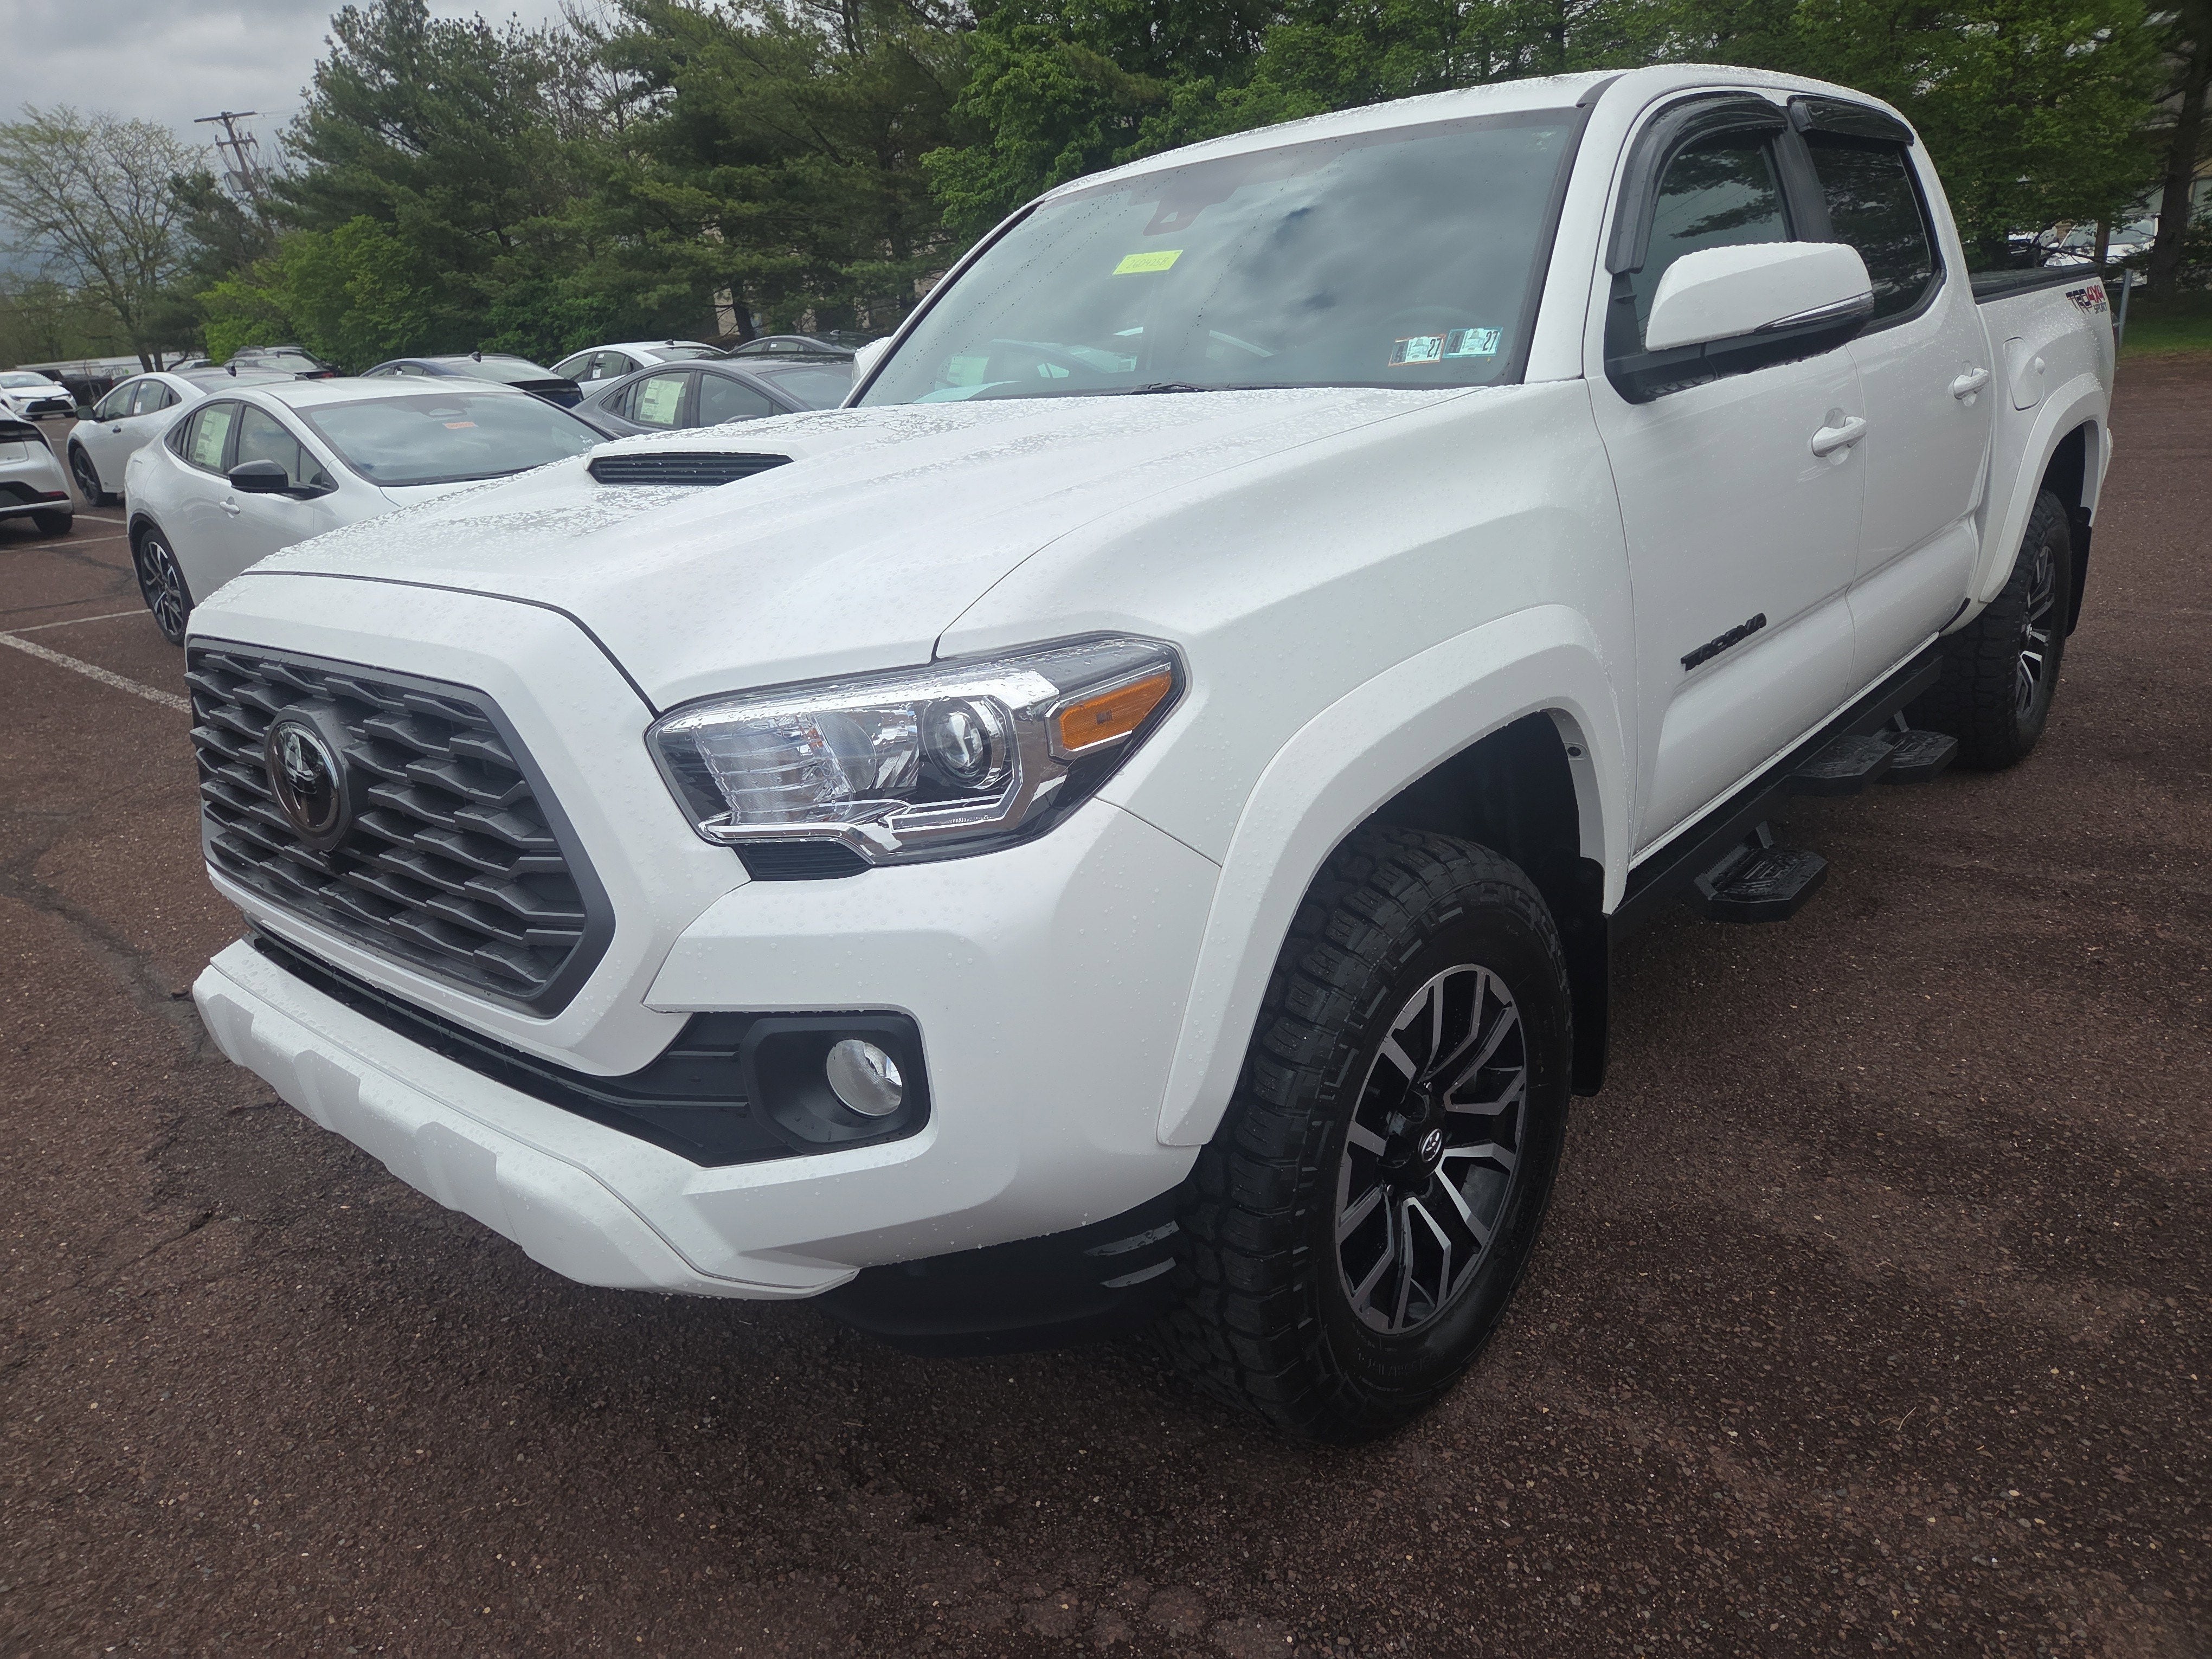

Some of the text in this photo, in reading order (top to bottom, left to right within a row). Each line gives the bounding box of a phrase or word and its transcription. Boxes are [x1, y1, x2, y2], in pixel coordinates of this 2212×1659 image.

[2065, 288, 2093, 316] TRD
[2093, 302, 2107, 314] SPORT
[1427, 338, 1442, 359] 27
[1482, 331, 1499, 352] 27
